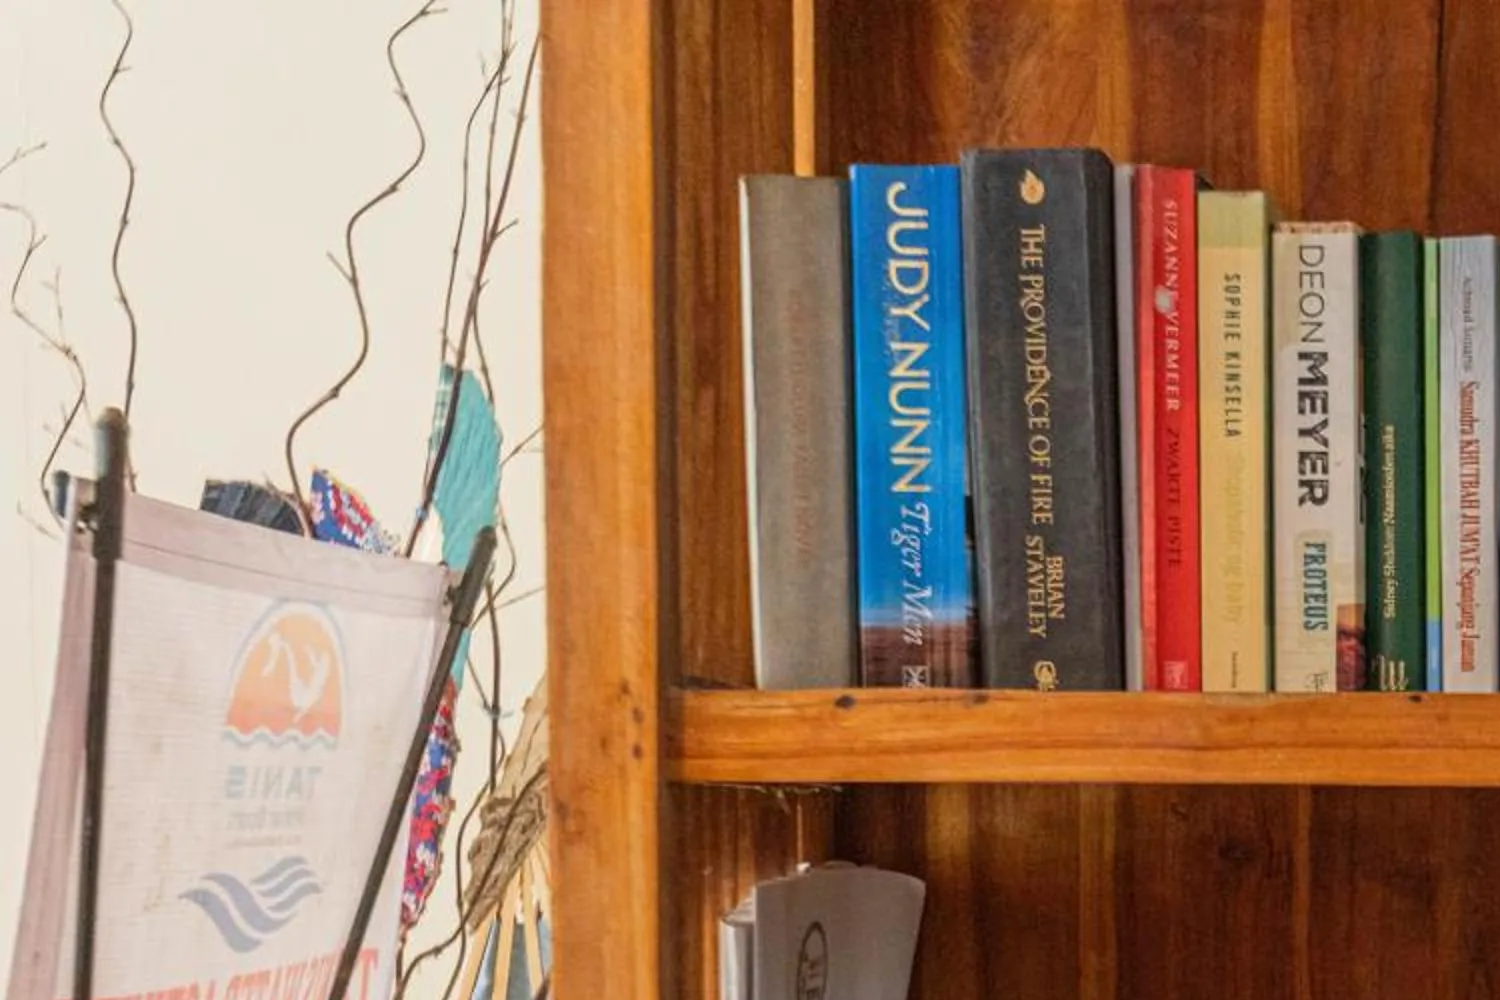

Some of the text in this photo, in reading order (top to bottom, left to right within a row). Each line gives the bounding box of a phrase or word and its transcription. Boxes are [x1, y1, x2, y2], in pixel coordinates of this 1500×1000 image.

[888, 182, 931, 494] JUDY NUNN
[1017, 223, 1054, 526] THE PROVIDENCE OF FIRE
[1163, 310, 1184, 412] VERMEER
[1223, 272, 1243, 440] SOPHIE KINSELLA
[1297, 244, 1329, 508] DEON MEYER
[1459, 381, 1481, 435] Samudra
[1166, 426, 1184, 569] ZWARTE PISTE
[1459, 439, 1481, 510] KHUTBAH
[891, 500, 933, 646] Tiger Men
[1025, 535, 1048, 638] STAVELEY
[1047, 555, 1066, 620] BRIAN
[1302, 541, 1331, 633] PROTEUS
